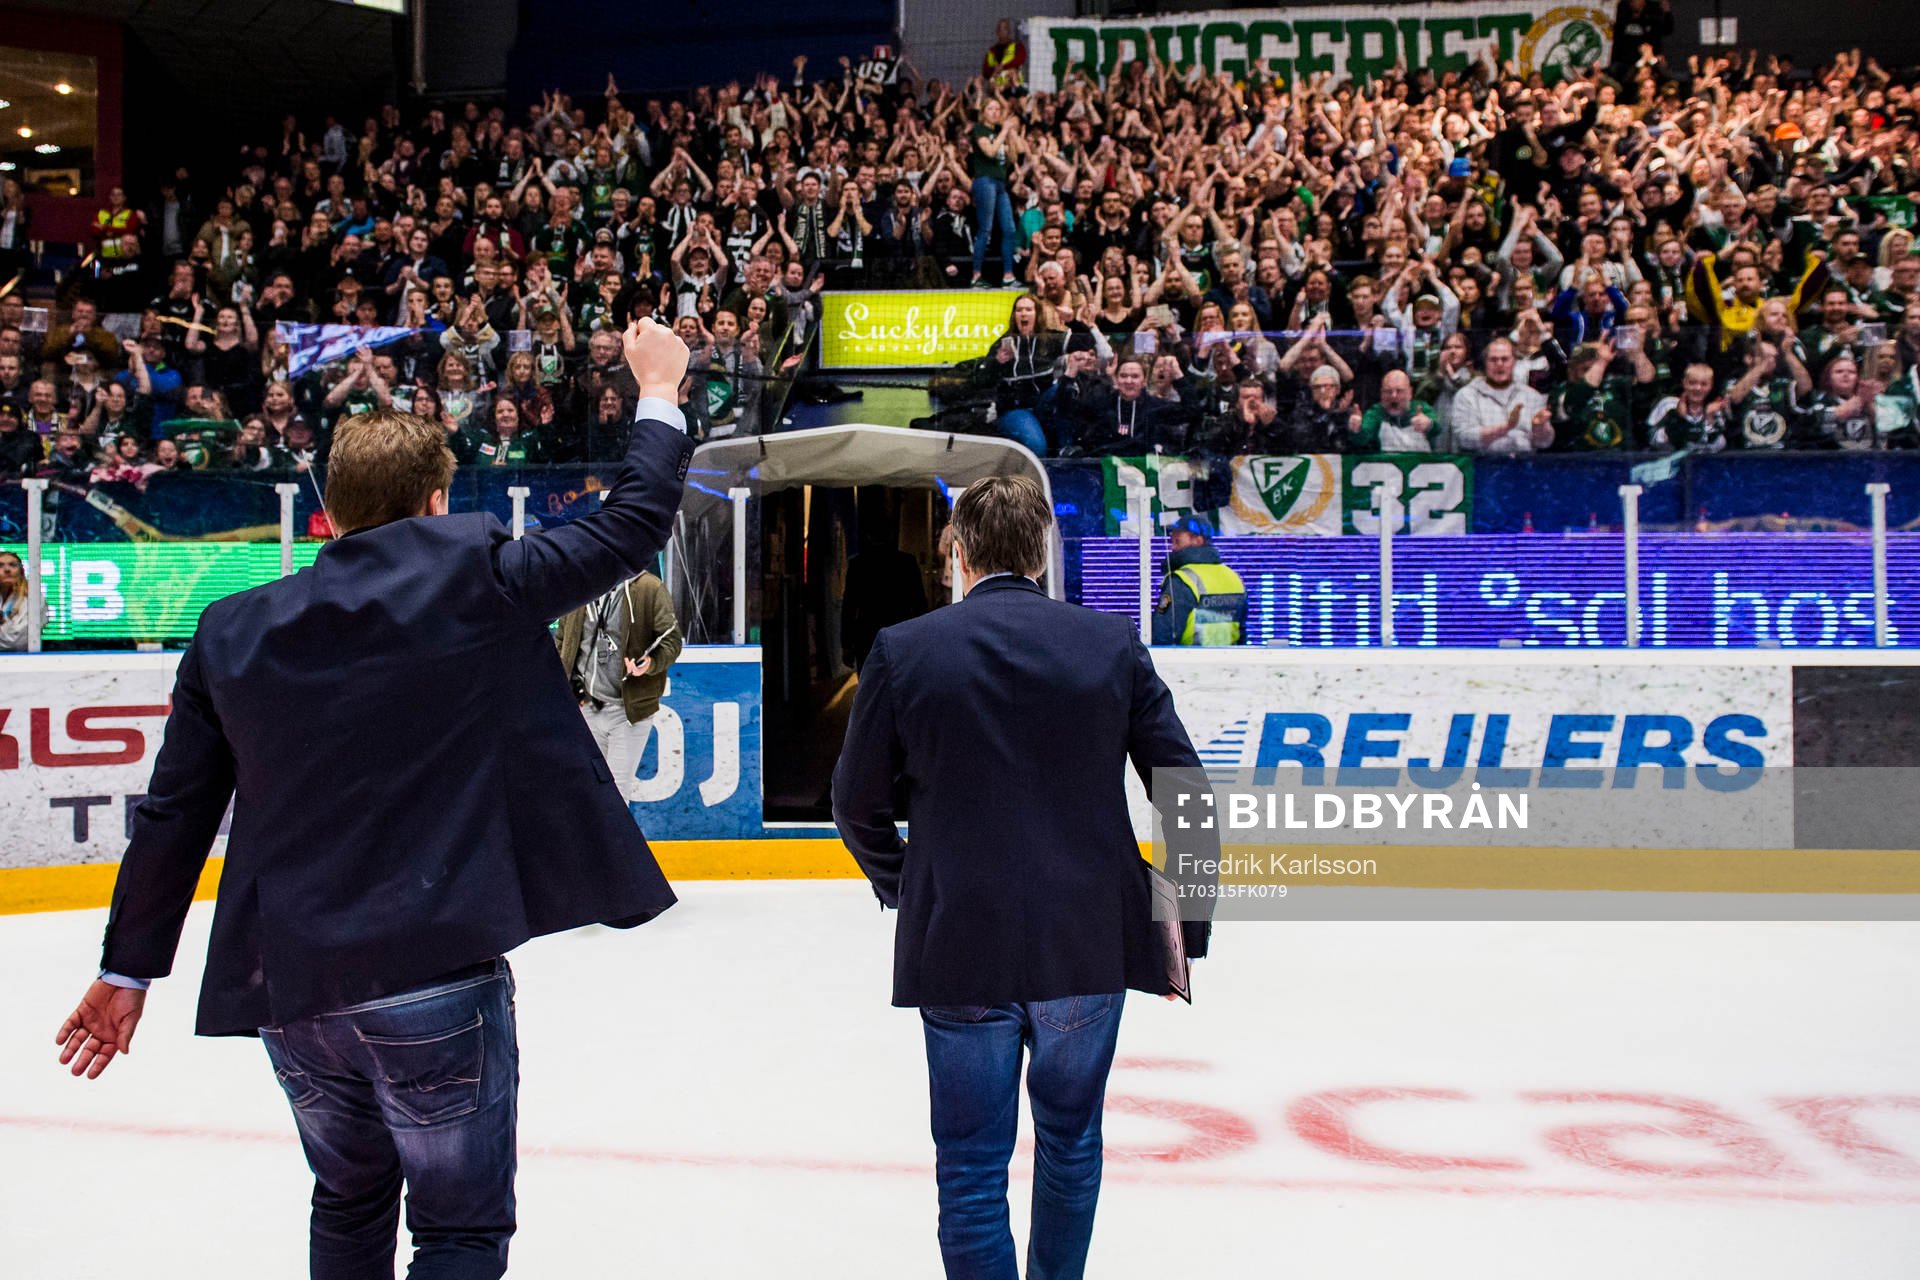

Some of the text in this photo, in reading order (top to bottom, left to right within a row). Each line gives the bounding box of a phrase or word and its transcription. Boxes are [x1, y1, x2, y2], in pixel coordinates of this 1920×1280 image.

[838, 302, 1004, 355] Luckylane
[1351, 462, 1467, 535] 32
[1252, 712, 1768, 791] REJLERS
